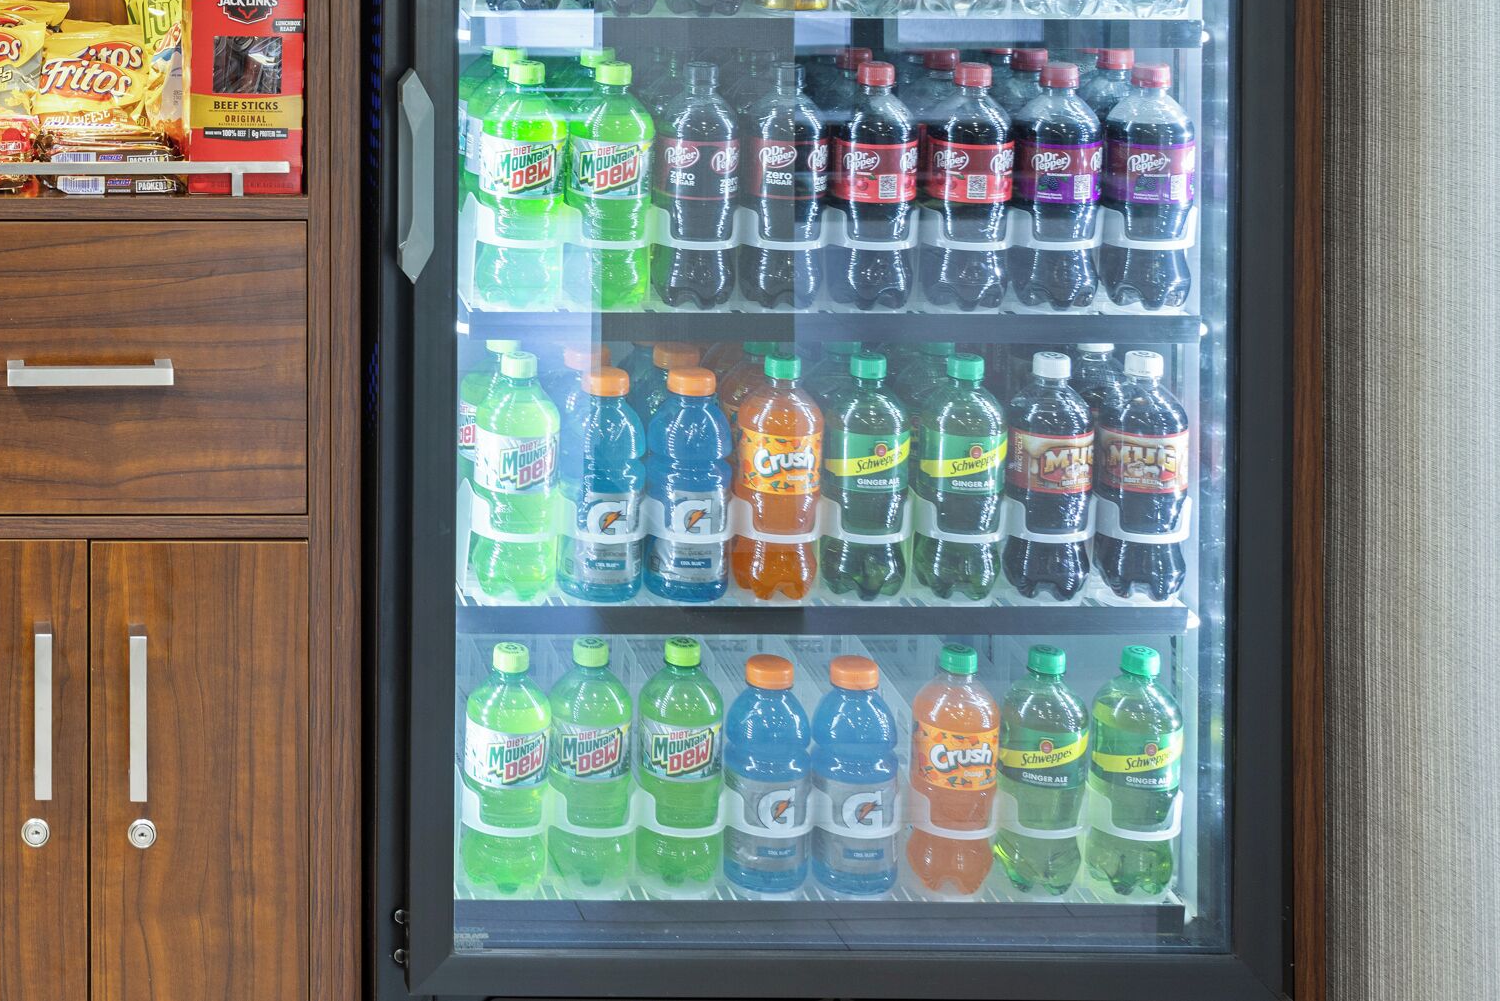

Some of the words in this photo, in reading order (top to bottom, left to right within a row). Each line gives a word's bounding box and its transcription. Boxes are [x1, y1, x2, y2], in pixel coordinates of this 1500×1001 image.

[40, 58, 132, 97] Fritos
[214, 101, 239, 110] BEEF
[242, 101, 278, 110] STICKS
[225, 115, 266, 123] ORIGINAL
[222, 129, 237, 137] 100%
[513, 147, 531, 156] DIET
[597, 147, 616, 155] DIET
[1036, 158, 1067, 172] Pepper
[1131, 159, 1166, 174] Pepper
[669, 171, 695, 180] zero
[765, 171, 792, 180] zero
[754, 449, 815, 475] Crush
[1109, 445, 1176, 472] MUG
[857, 478, 886, 487] GINGER
[952, 480, 982, 488] GINGER
[578, 731, 597, 740] DIET
[670, 730, 689, 740] DIET
[507, 737, 526, 747] DIET
[930, 745, 993, 770] Crush
[1022, 773, 1051, 783] GINGER
[1052, 775, 1068, 783] ALE
[1126, 776, 1155, 785] GINGER
